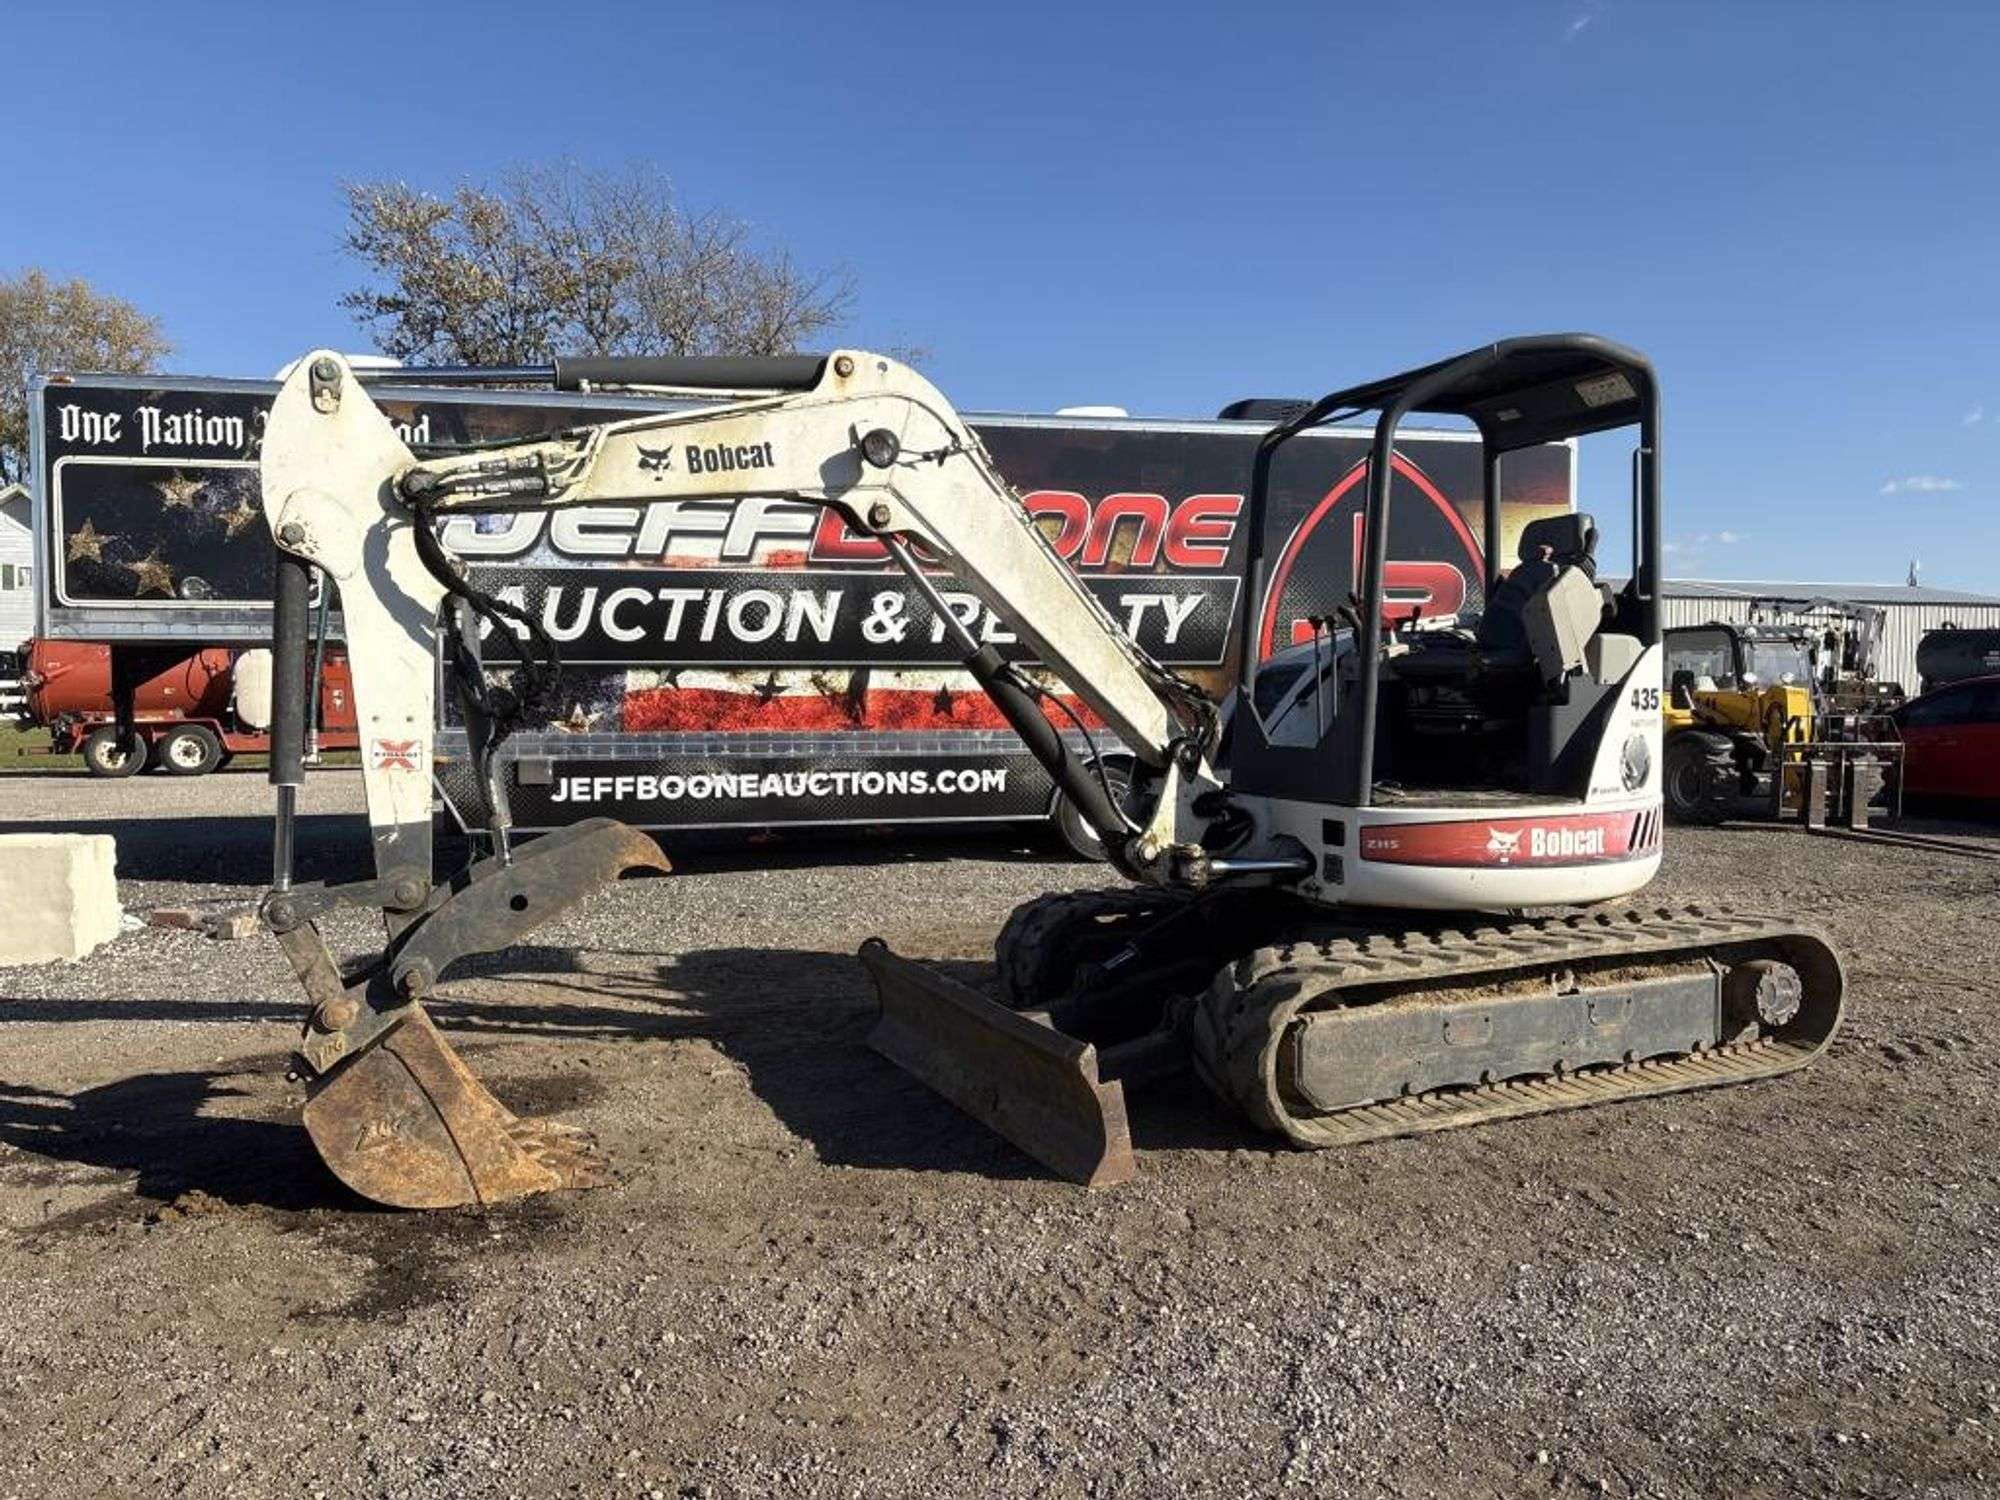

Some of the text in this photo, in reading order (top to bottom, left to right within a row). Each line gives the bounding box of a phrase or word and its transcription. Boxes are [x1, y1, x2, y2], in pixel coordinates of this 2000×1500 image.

[59, 404, 121, 445] One
[134, 405, 245, 455] Nation
[394, 413, 430, 444] od
[686, 441, 775, 474] Bobcat
[479, 585, 845, 643] AUCTION
[862, 588, 908, 644] &
[1631, 687, 1659, 711] 435
[551, 768, 1008, 802] JEFFBOONEAUCTIONS.COM
[1531, 827, 1605, 857] Bobcat
